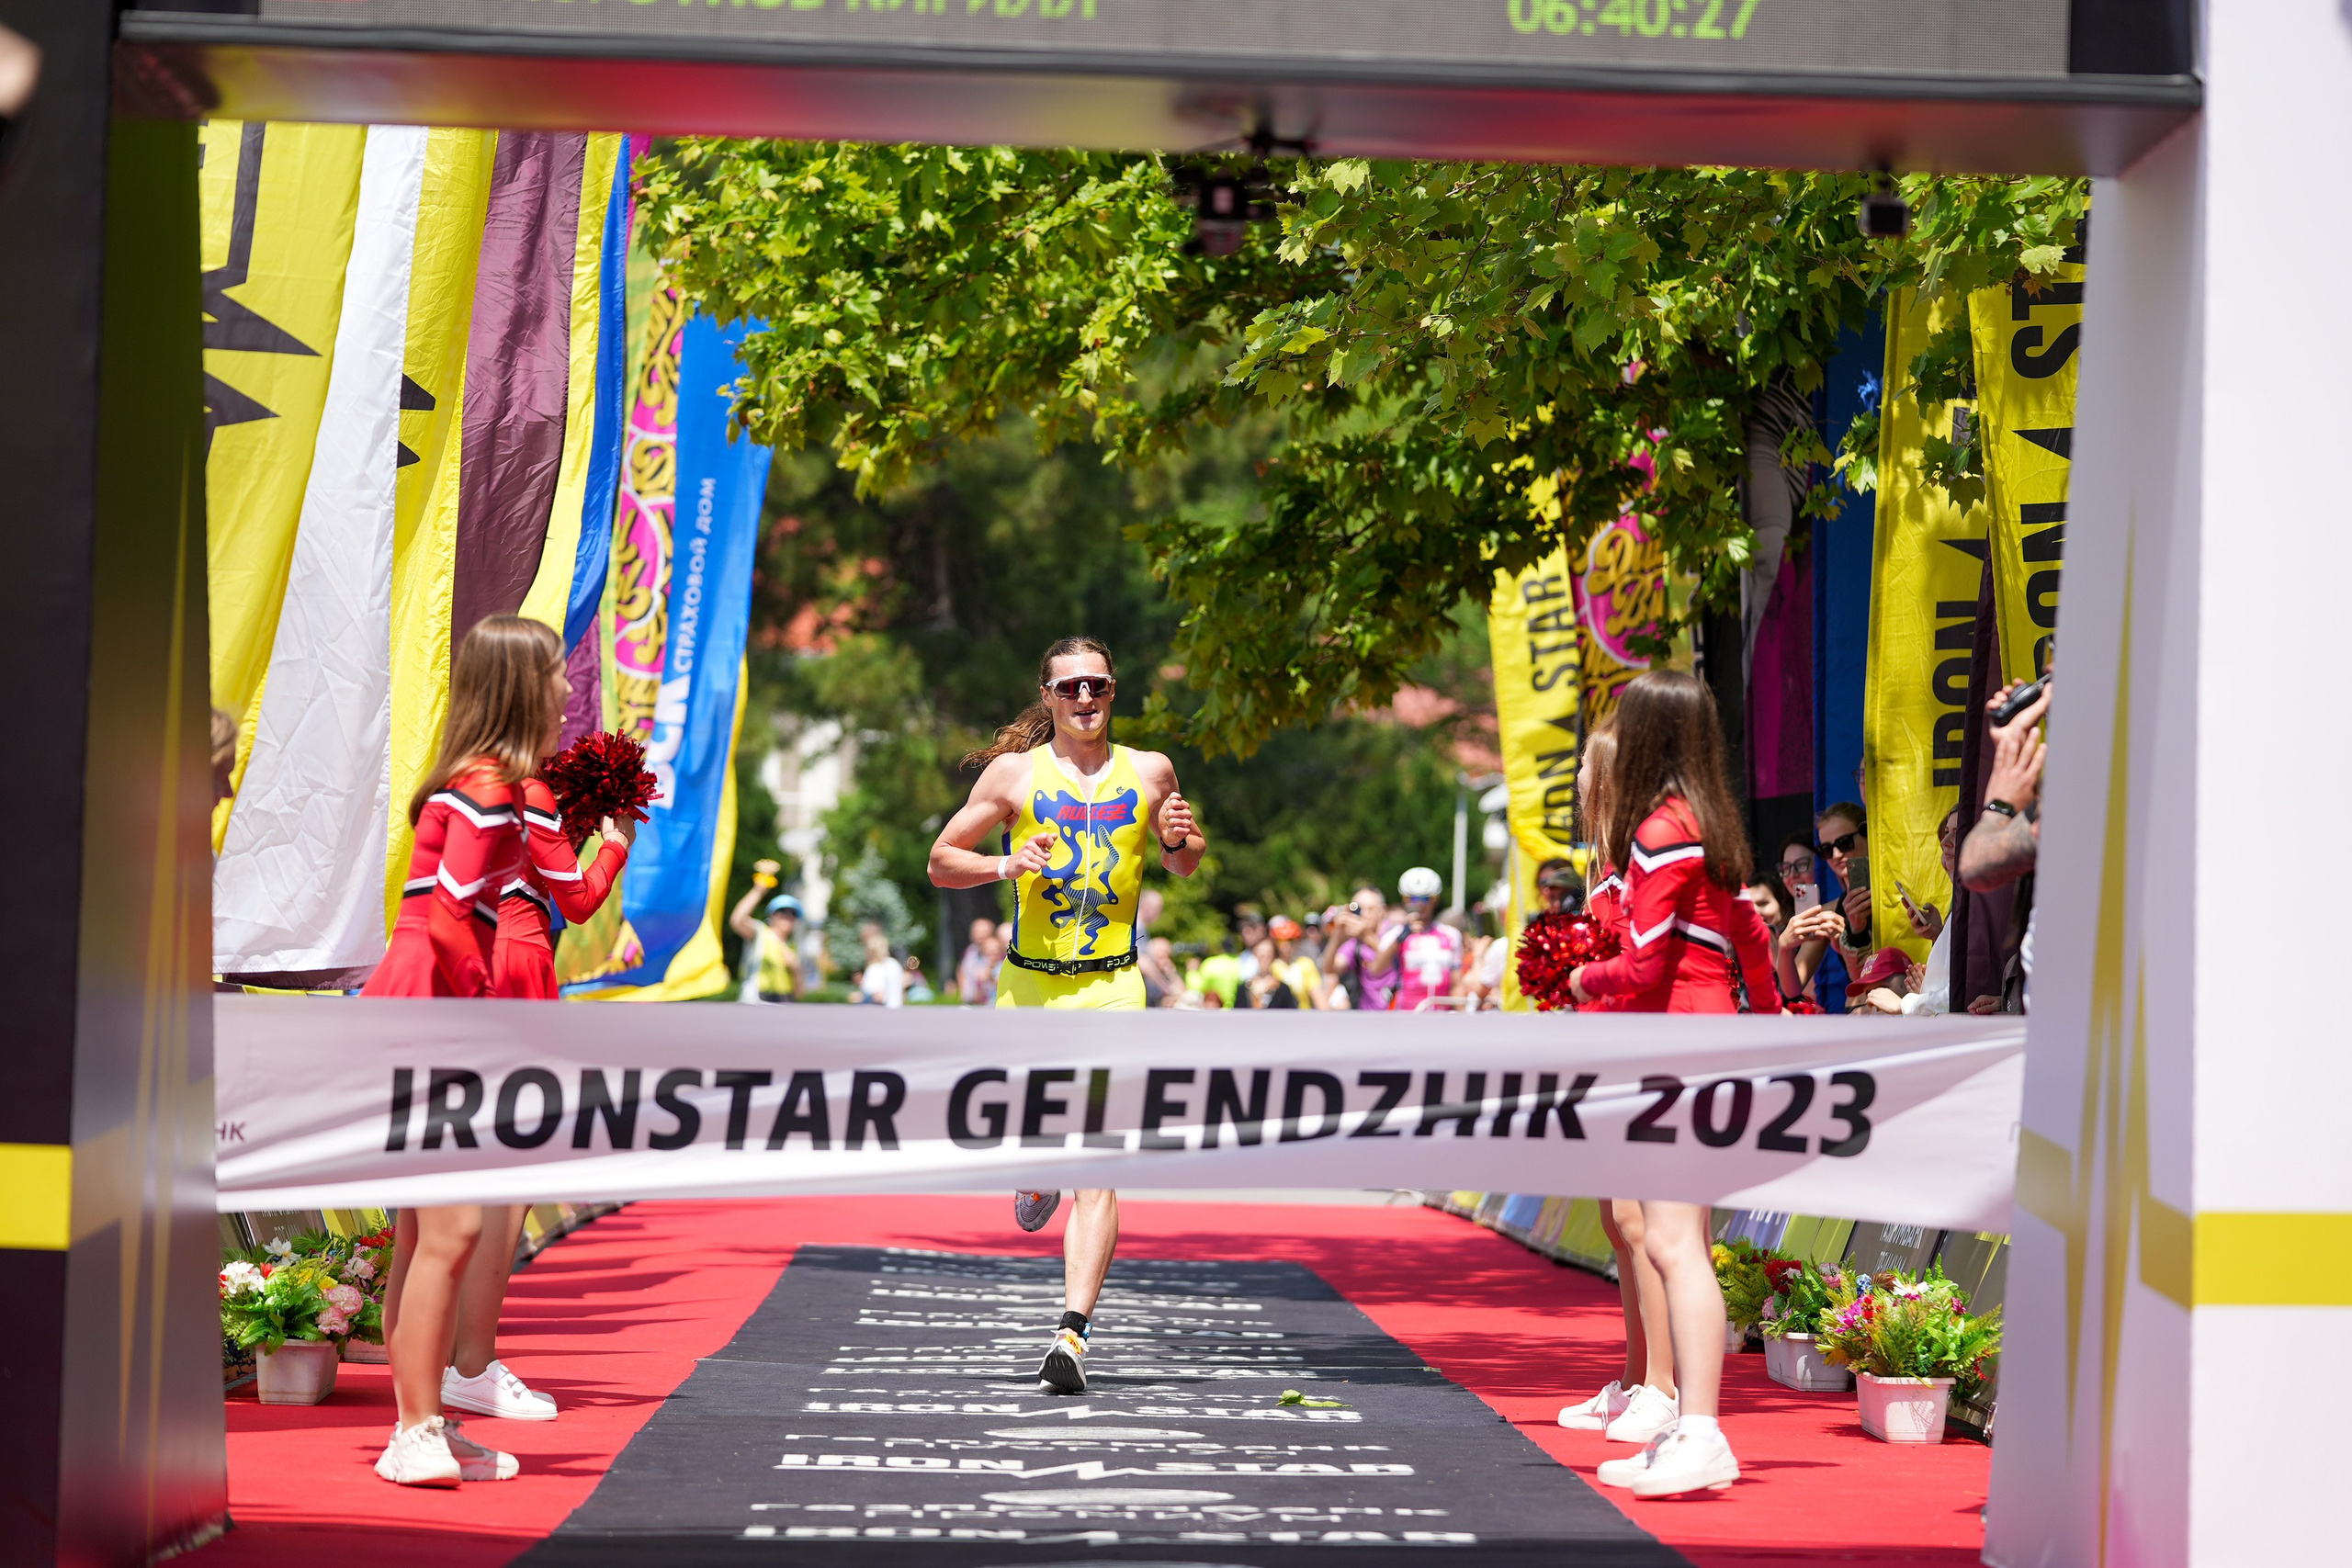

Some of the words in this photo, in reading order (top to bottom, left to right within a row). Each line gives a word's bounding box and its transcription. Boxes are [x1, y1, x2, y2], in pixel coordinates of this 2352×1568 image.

[673, 536, 707, 673] СТРАХОВОЙ
[695, 478, 717, 535] ДОМ
[1522, 575, 1580, 693] STAR
[385, 1066, 906, 1152] IRONSTAR
[946, 1067, 1599, 1150] GELENDZHIK
[1626, 1070, 1877, 1157] 2023
[806, 1402, 1021, 1413] IRON
[1136, 1406, 1363, 1420] STAR
[780, 1454, 1025, 1471] IRON
[1155, 1462, 1415, 1473] STAR
